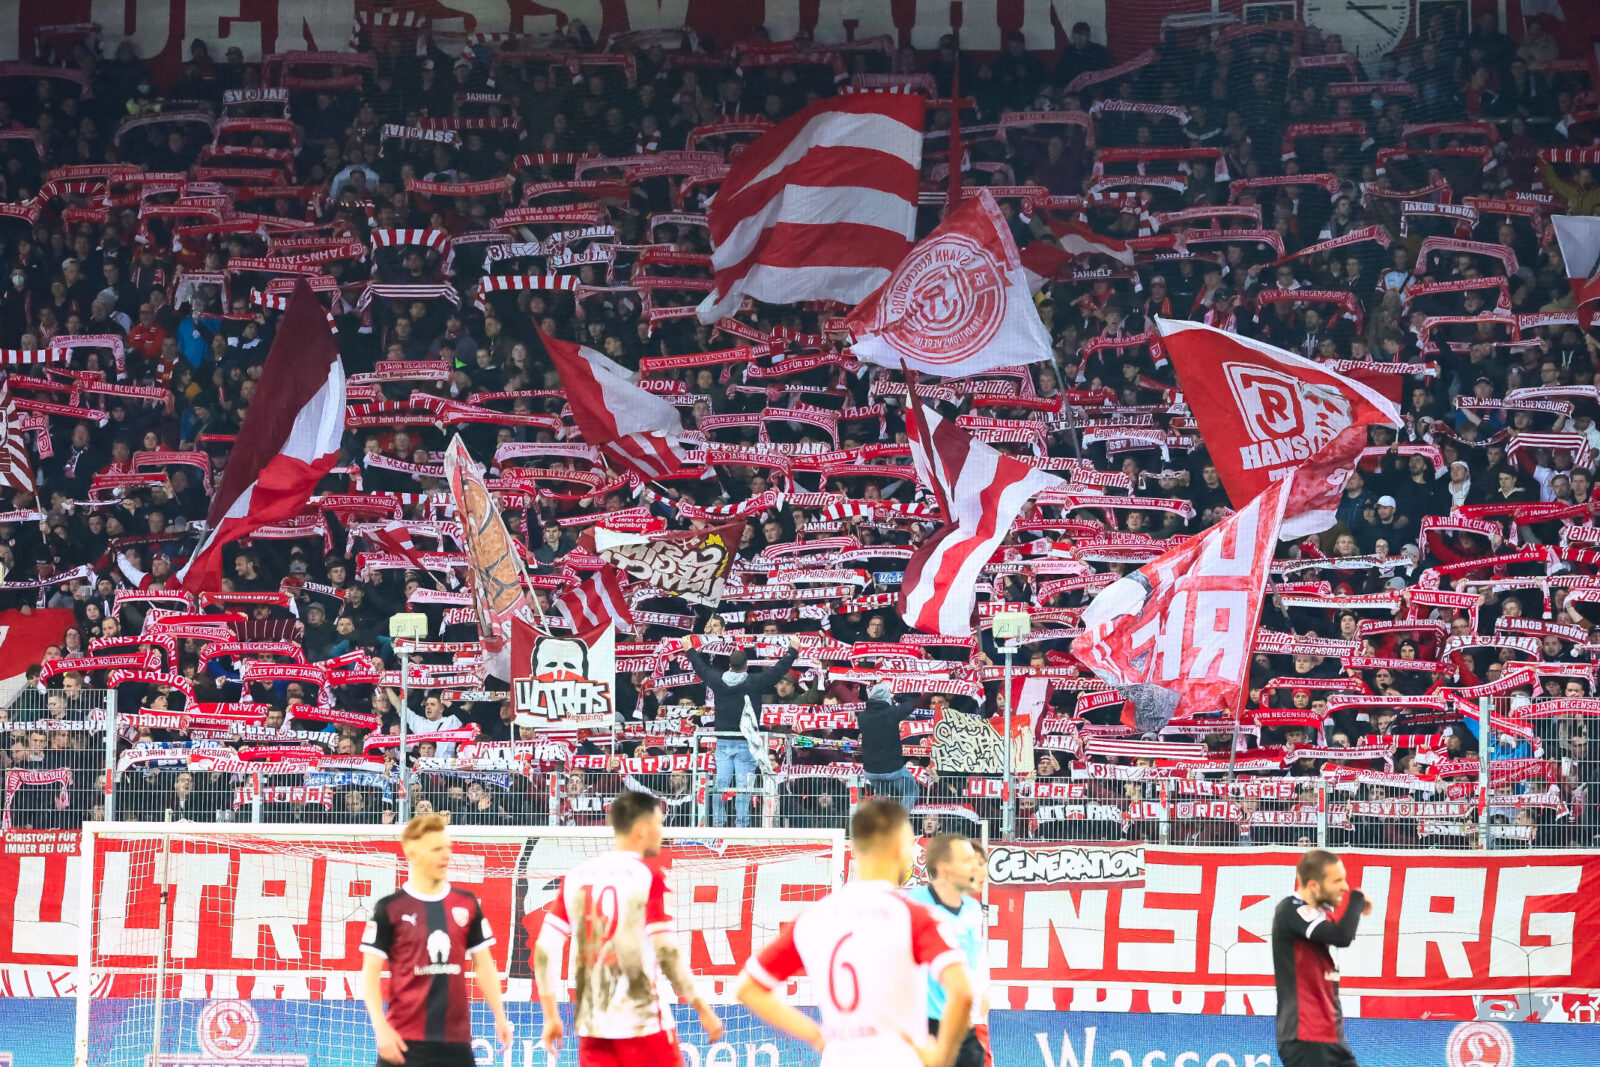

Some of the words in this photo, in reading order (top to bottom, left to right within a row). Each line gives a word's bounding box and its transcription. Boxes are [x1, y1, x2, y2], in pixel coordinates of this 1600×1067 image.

[440, 183, 466, 192] JAKOB
[1515, 192, 1553, 203] JAHNELF
[1072, 270, 1112, 279] JAHNELF
[1263, 291, 1278, 299] SSV
[1280, 290, 1298, 298] JAHN
[1299, 290, 1347, 299] REGENSBURG
[647, 359, 662, 368] SSV
[664, 358, 682, 367] JAHN
[684, 350, 746, 364] REGENSBURG
[766, 366, 785, 374] ALLES
[91, 380, 113, 392] JAHN
[114, 382, 168, 396] REGENSBURG
[639, 380, 675, 392] DION
[1462, 396, 1478, 407] SSV
[1479, 397, 1501, 407] JAHN
[362, 416, 376, 424] SSV
[379, 415, 394, 424] Jahn
[395, 415, 436, 425] Regensburg
[971, 418, 994, 427] JAHN
[1239, 435, 1310, 470] HANS
[818, 454, 847, 463] JAKOB
[519, 467, 545, 478] JAHN
[803, 522, 842, 531] JAHNELF
[1437, 517, 1460, 526] JAHN
[874, 549, 914, 557] Regensburg
[1499, 554, 1521, 562] JAHN
[984, 564, 1024, 572] JAHNELF
[776, 570, 802, 581] Gegen
[417, 590, 431, 598] SSV
[433, 591, 449, 599] JAHN
[1414, 593, 1437, 602] JAHN
[1350, 597, 1398, 607] FANATICA
[1374, 620, 1392, 628] 2000
[1511, 619, 1542, 630] JAKOB
[150, 624, 162, 634] SSV
[163, 624, 183, 633] JAHN
[184, 625, 231, 639] REGENSBURG
[219, 643, 241, 651] JAHN
[242, 642, 294, 655] REGENSBURG
[1255, 643, 1279, 653] JAHN
[1292, 644, 1352, 658] REGENSBURG
[98, 656, 138, 664] TRADITION
[1351, 658, 1365, 666] SSV
[1368, 658, 1386, 666] JAHN
[1388, 660, 1437, 670] REGENSBURG
[266, 668, 281, 679] FÜR
[282, 668, 297, 679] DIE
[346, 670, 365, 678] JAHN
[654, 673, 696, 688] JAHNELF
[1472, 672, 1530, 698] REGENSBURG
[892, 679, 972, 694] Jahnfamilie
[514, 680, 612, 720] ULTRAS
[1364, 694, 1384, 703] FÜR
[1386, 695, 1402, 703] DIE
[228, 703, 253, 712] JAHN
[1536, 703, 1558, 712] JAHN
[295, 706, 310, 714] SSV
[311, 707, 330, 716] JAHN
[331, 709, 376, 723] REGENSBURG
[1271, 709, 1321, 720] REGENSBURG
[127, 750, 143, 759] SSV
[146, 749, 166, 757] JAHN
[182, 749, 232, 758] REGENSBURG
[1359, 802, 1392, 815] SSV
[1415, 803, 1459, 815] JAHN
[5, 832, 56, 842] CHRISTOPH
[58, 832, 77, 842] FÜR
[4, 844, 34, 854] IMMER
[36, 844, 55, 854] BEI
[57, 843, 76, 853] UNS
[988, 847, 1146, 884] GENERATION
[829, 931, 861, 1014] 6
